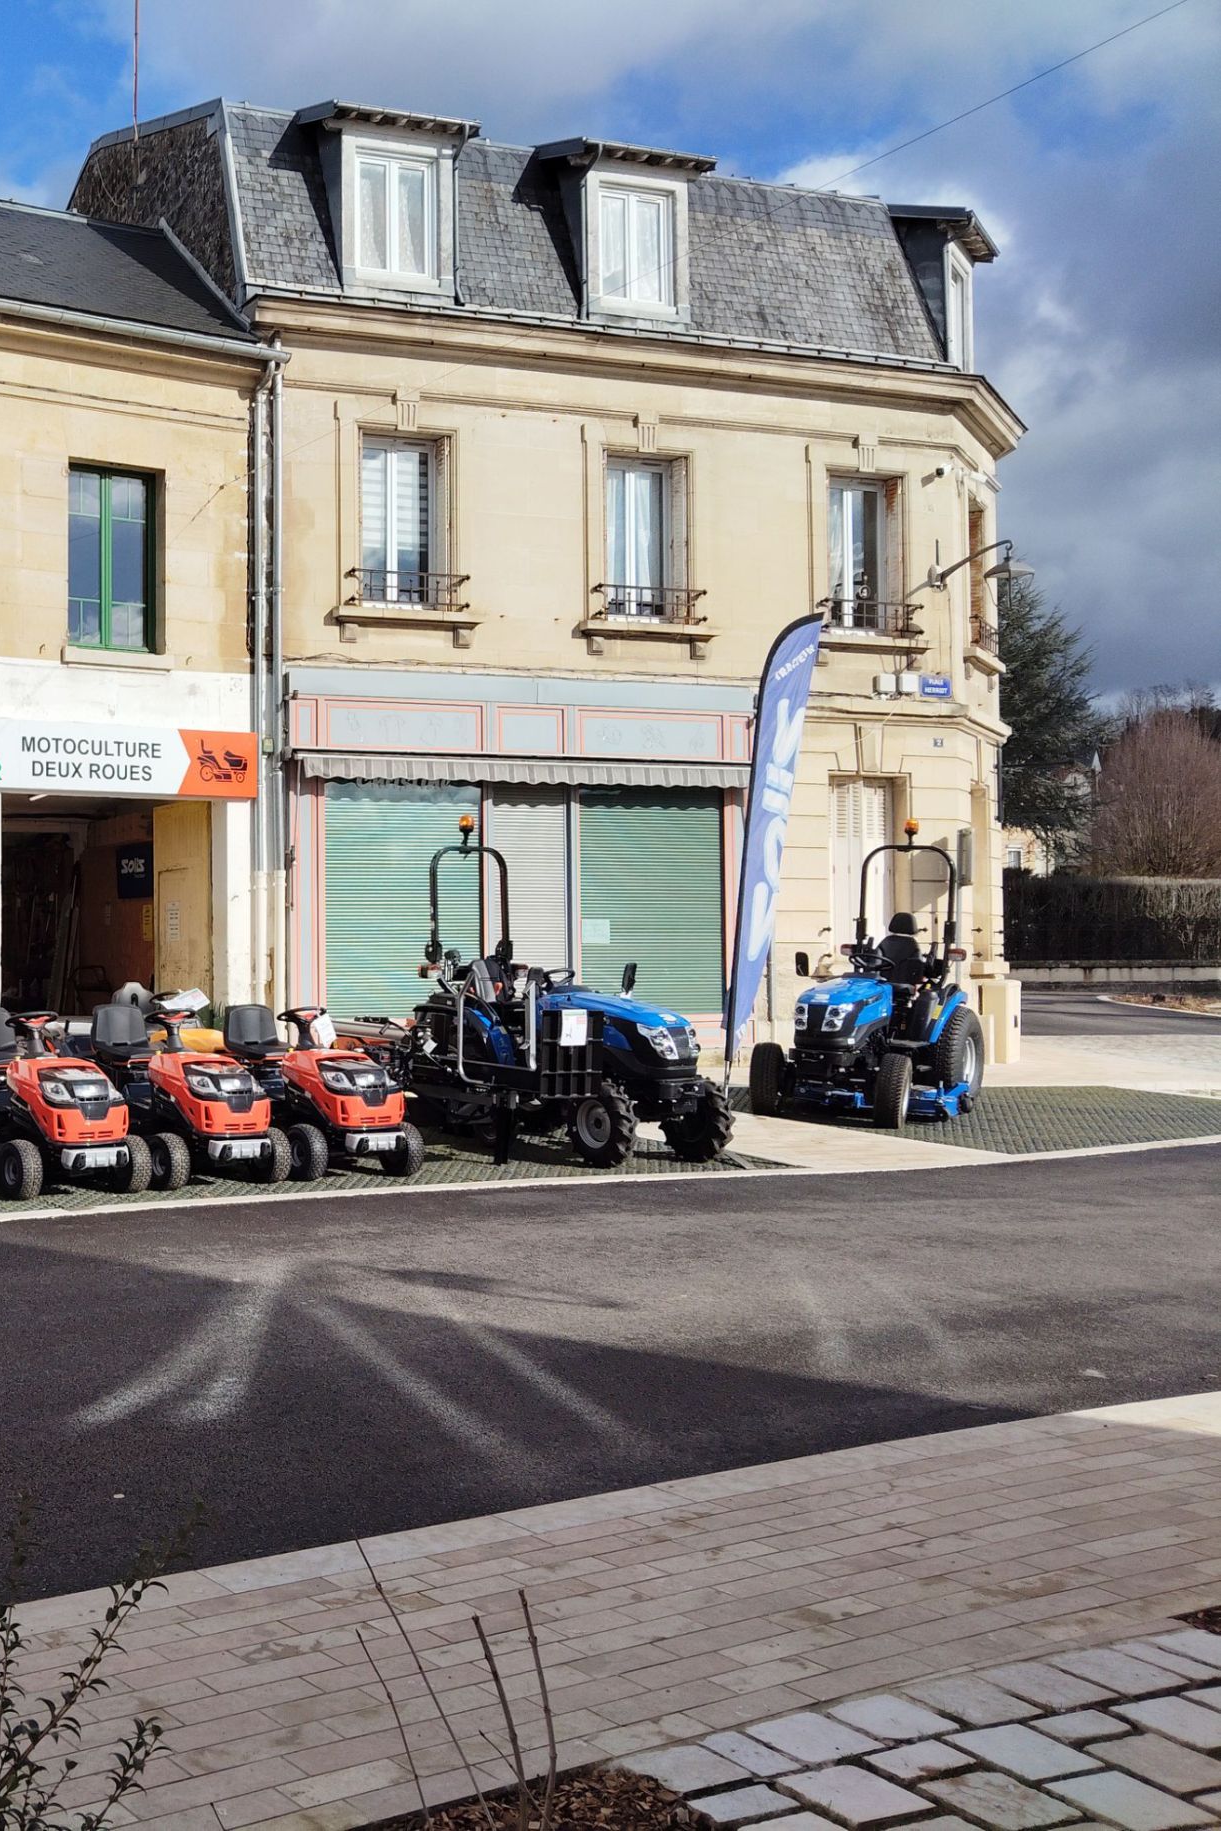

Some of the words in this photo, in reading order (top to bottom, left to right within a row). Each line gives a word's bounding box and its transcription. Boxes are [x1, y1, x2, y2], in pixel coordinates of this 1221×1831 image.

[21, 736, 162, 758] MOTOCULTURE
[32, 760, 83, 779] DEUX
[89, 763, 152, 782] ROUES
